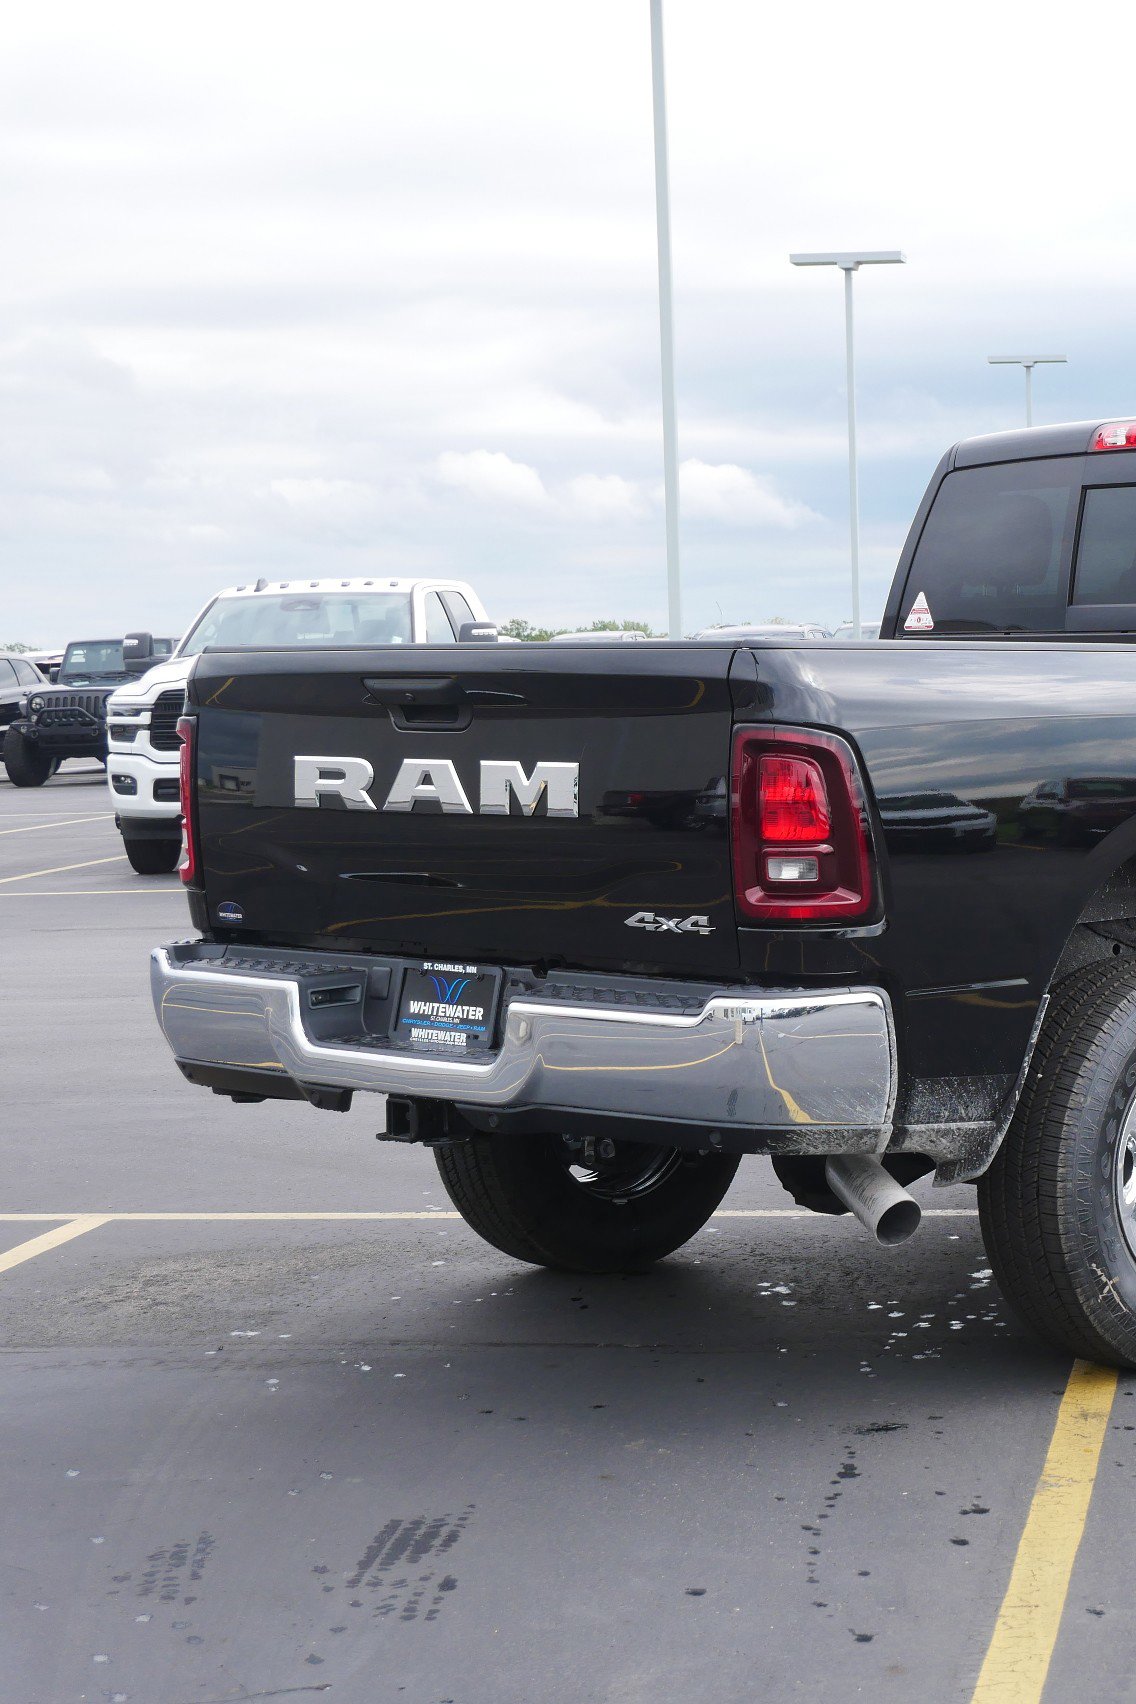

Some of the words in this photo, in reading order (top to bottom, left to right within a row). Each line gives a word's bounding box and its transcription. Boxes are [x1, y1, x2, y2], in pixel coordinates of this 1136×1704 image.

[294, 755, 580, 818] RAM
[623, 911, 716, 935] 4x4
[423, 962, 433, 970] ST.
[433, 963, 465, 973] CHARLES,
[466, 965, 478, 974] MN
[410, 1000, 484, 1021] WHITEWATER
[402, 1018, 431, 1026] CHRYSLER
[411, 1027, 467, 1043] WHITEWATER
